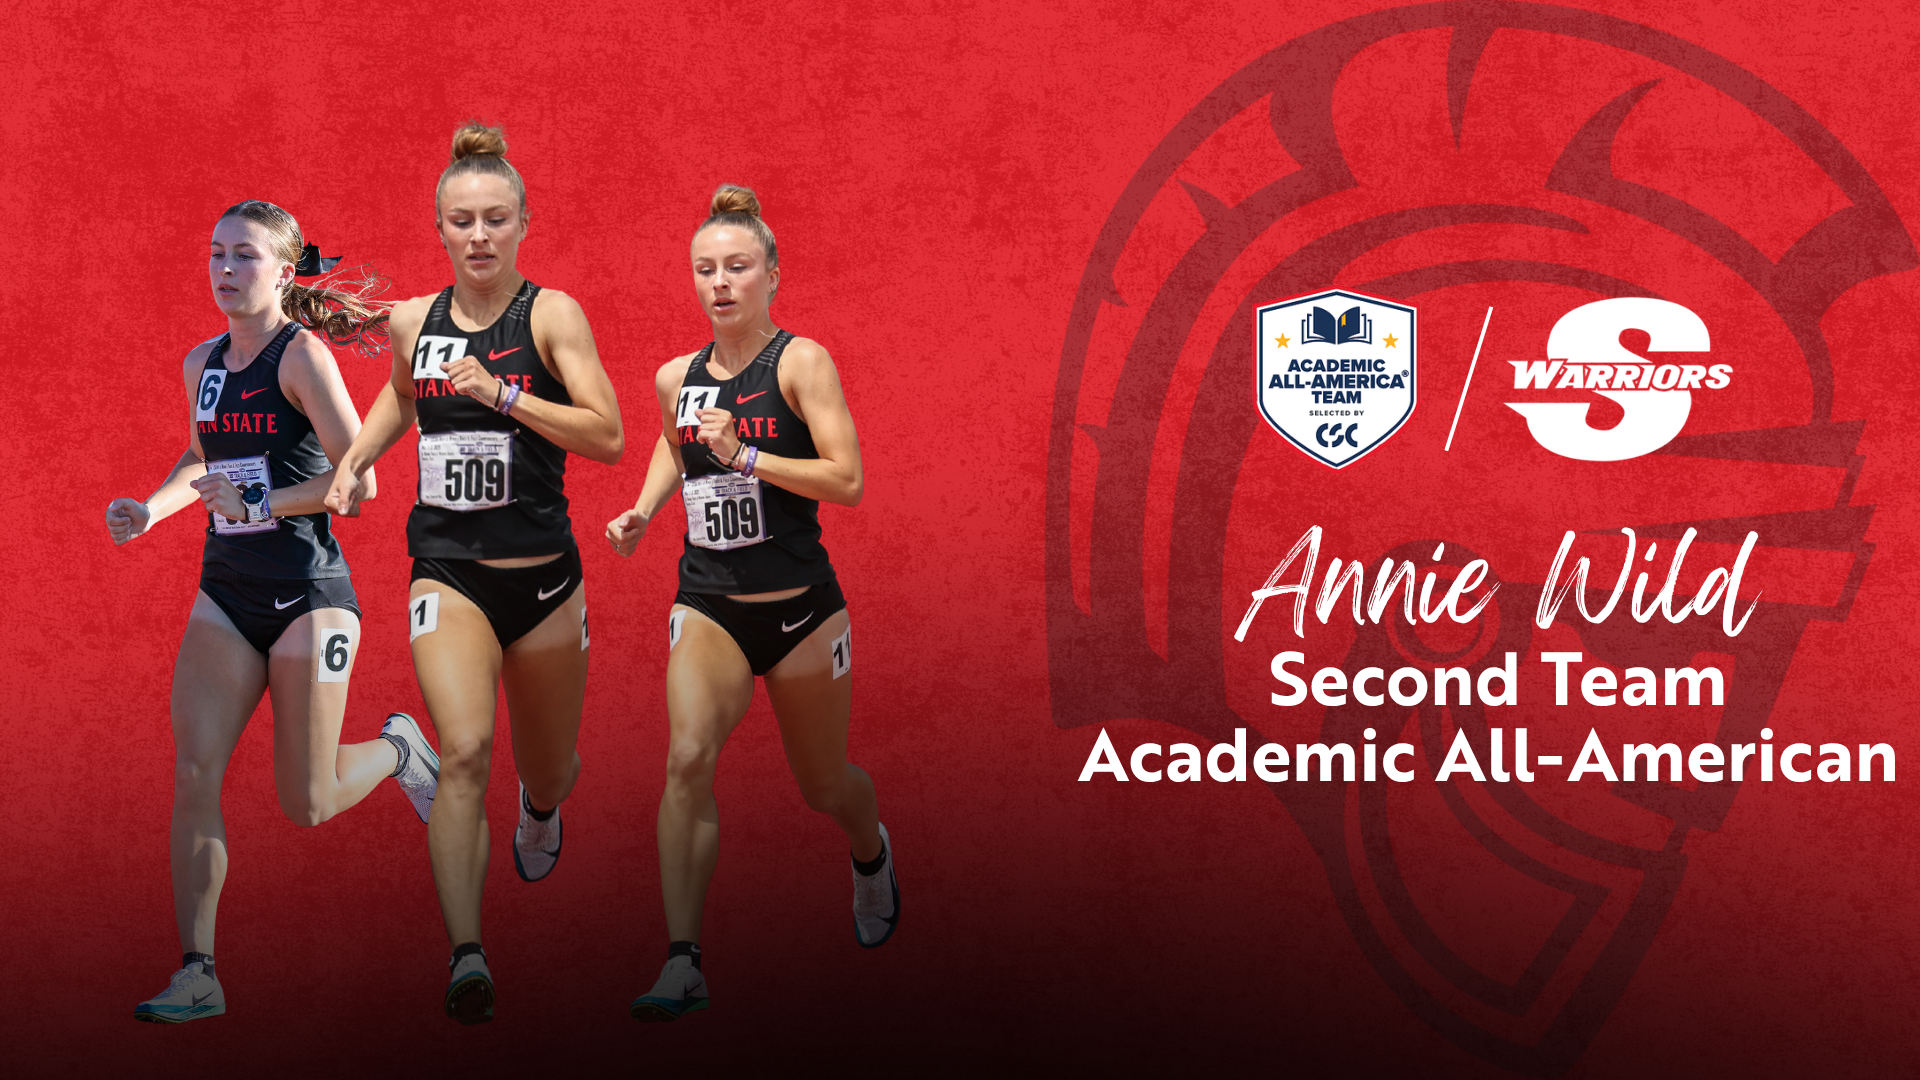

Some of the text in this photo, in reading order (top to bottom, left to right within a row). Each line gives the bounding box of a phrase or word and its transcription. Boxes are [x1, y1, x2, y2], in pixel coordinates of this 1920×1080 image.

[418, 341, 455, 369] 11
[200, 374, 222, 411] 6
[679, 391, 709, 418] 11
[222, 412, 278, 433] STATE
[445, 458, 505, 502] 509
[704, 497, 759, 542] 509
[325, 634, 349, 672] 6
